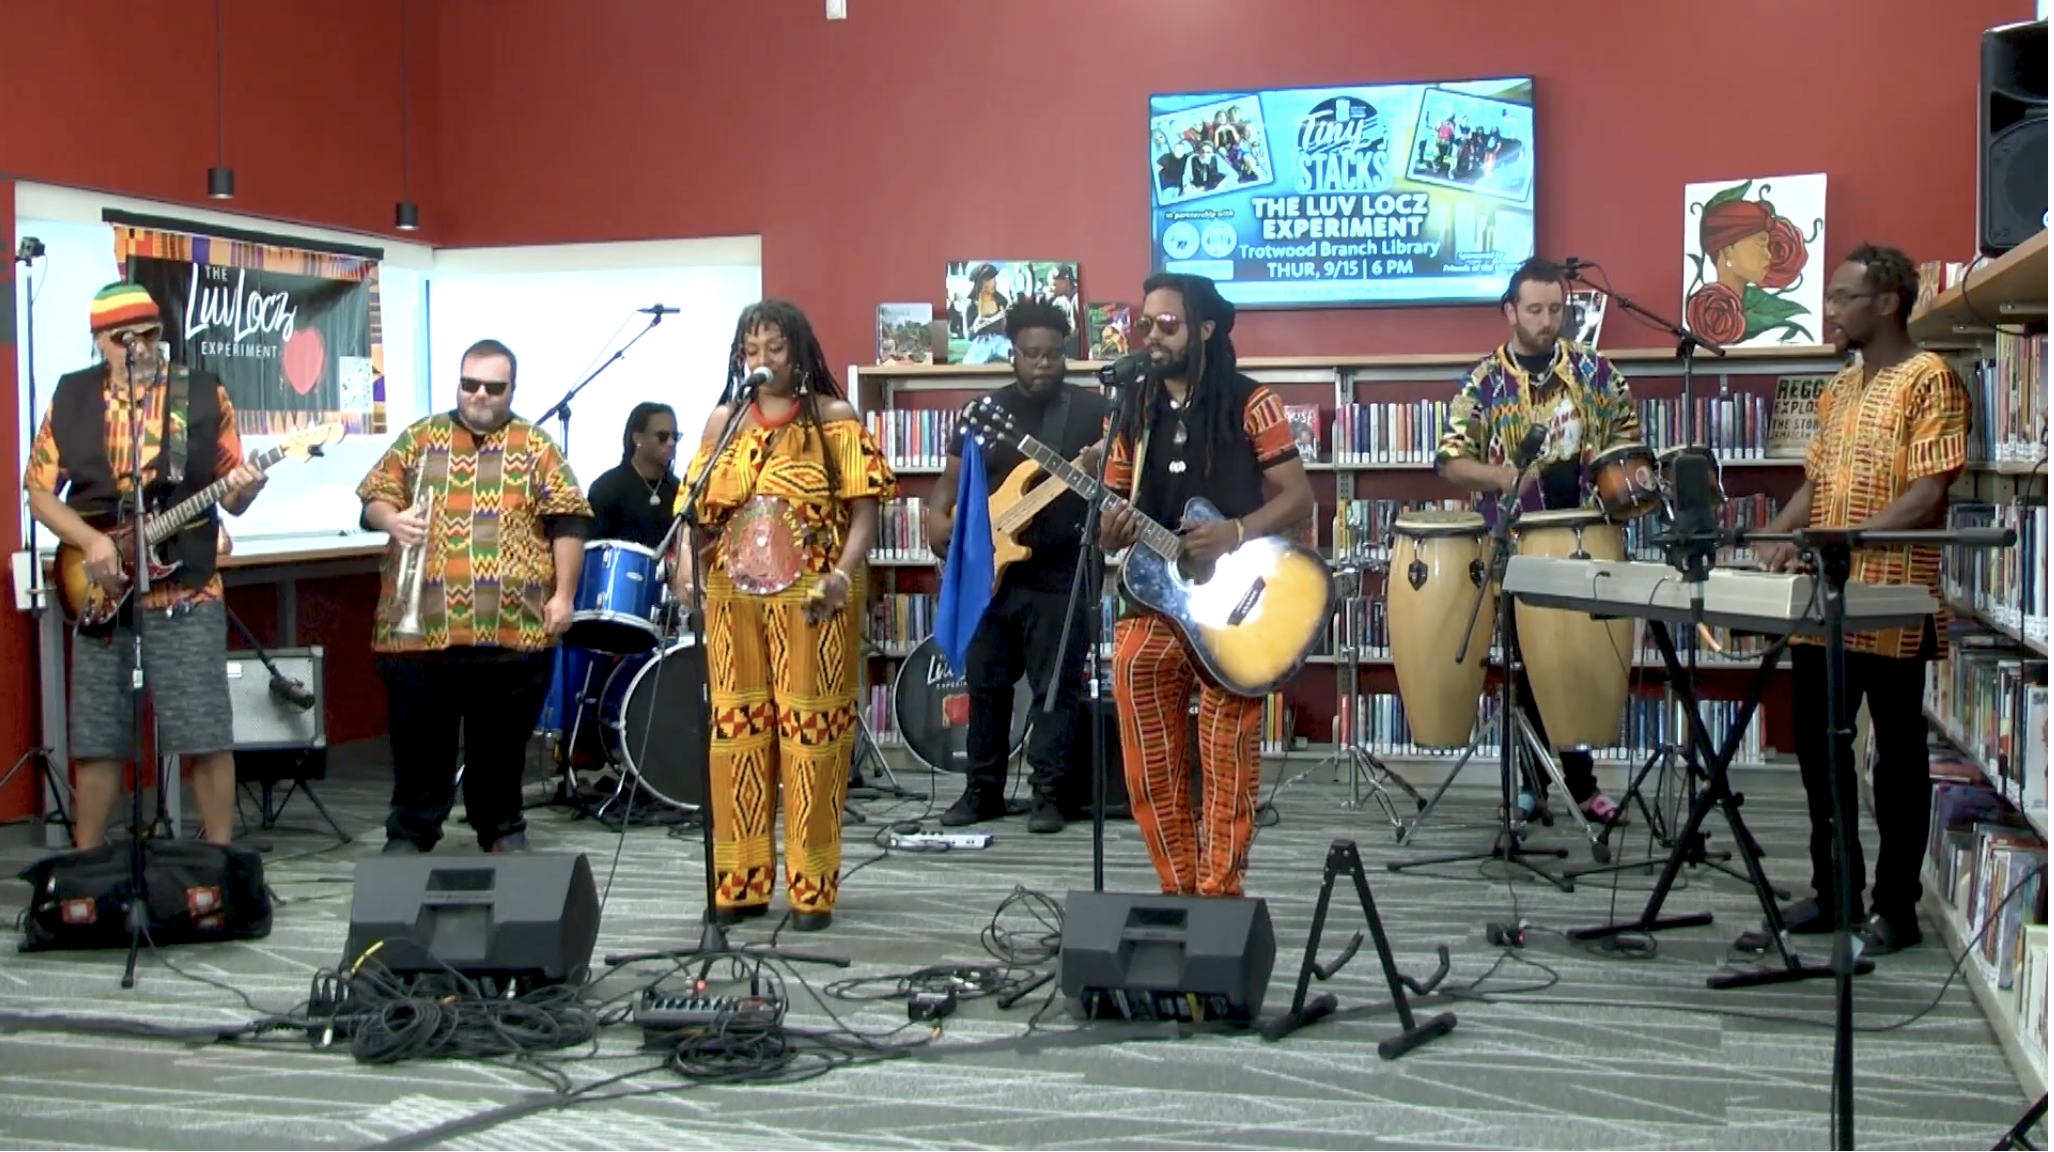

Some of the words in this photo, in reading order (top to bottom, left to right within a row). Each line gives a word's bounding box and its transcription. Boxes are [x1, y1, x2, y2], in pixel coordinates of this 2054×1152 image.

[1302, 110, 1372, 152] Tiny
[1298, 151, 1389, 190] STACKS
[1252, 197, 1300, 218] THE
[1306, 195, 1357, 217] LUV
[1362, 194, 1429, 215] LOCZ
[1263, 216, 1424, 239] EXPERIMENT
[1239, 241, 1316, 259] Trotwood
[1320, 239, 1377, 257] Branch
[1382, 238, 1441, 258] Library
[205, 265, 229, 282] THE
[1267, 262, 1320, 279] THUR,
[1323, 260, 1359, 279] 9/15
[1371, 260, 1382, 276] 6
[1387, 259, 1414, 274] PM
[201, 340, 279, 359] EXPERIMENT
[1776, 379, 1825, 400] REGG
[1773, 401, 1816, 415] EXPLO
[1794, 418, 1819, 430] STOR
